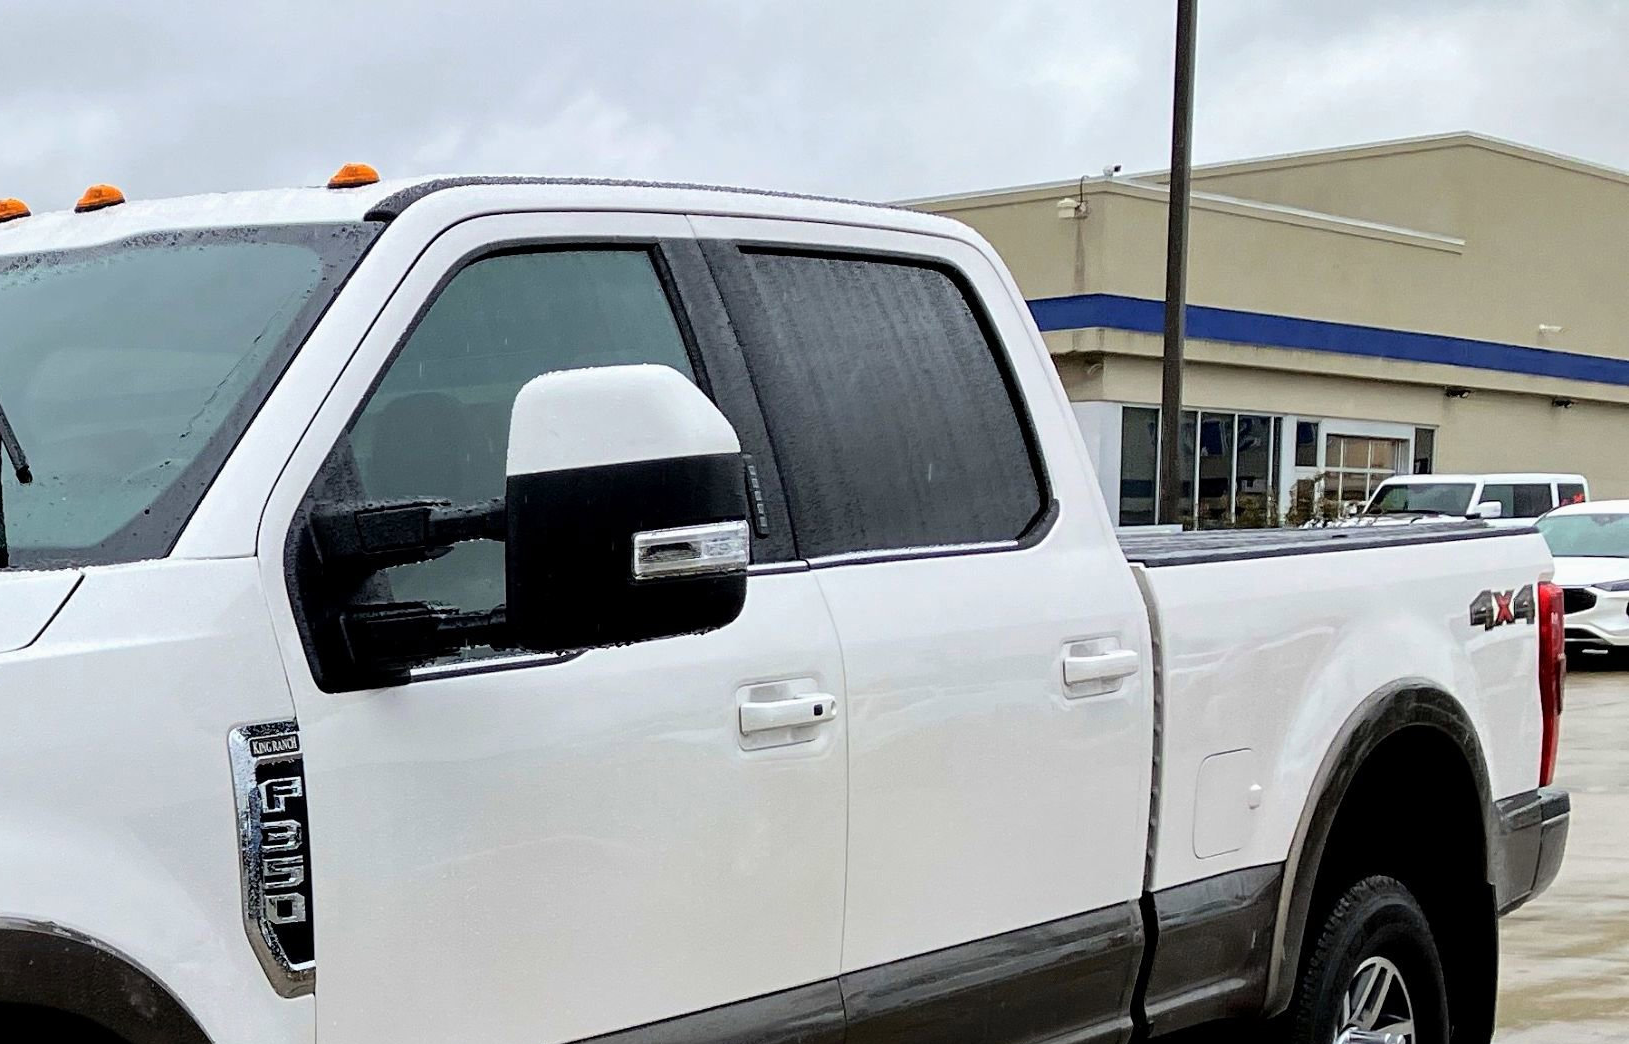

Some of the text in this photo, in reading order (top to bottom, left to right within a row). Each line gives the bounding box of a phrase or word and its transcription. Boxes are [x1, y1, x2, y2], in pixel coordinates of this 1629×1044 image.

[252, 735, 298, 755] KING RANCH
[258, 775, 307, 924] F350
